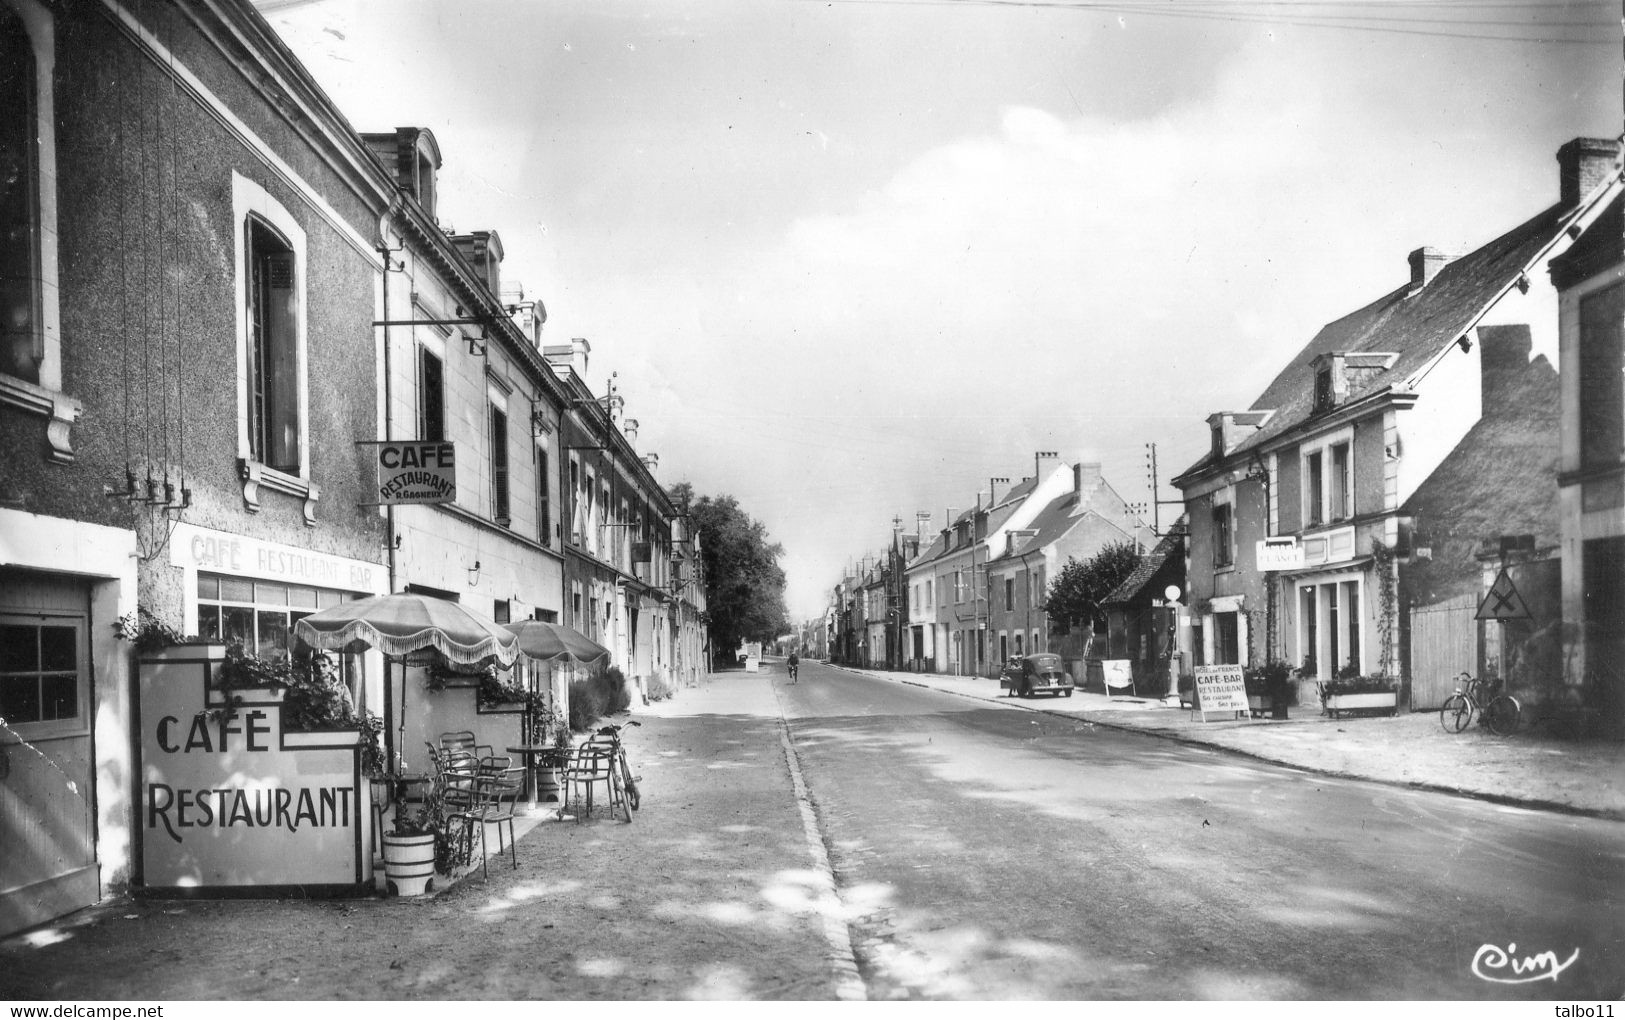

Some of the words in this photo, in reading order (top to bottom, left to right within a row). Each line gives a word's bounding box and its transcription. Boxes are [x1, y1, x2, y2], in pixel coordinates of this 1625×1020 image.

[380, 471, 456, 499] RESTAURANT
[257, 548, 339, 581] RESTAURANT
[350, 565, 372, 589] BAR
[1199, 685, 1245, 693] RESTAURANT
[149, 783, 353, 843] RESTAURANT
